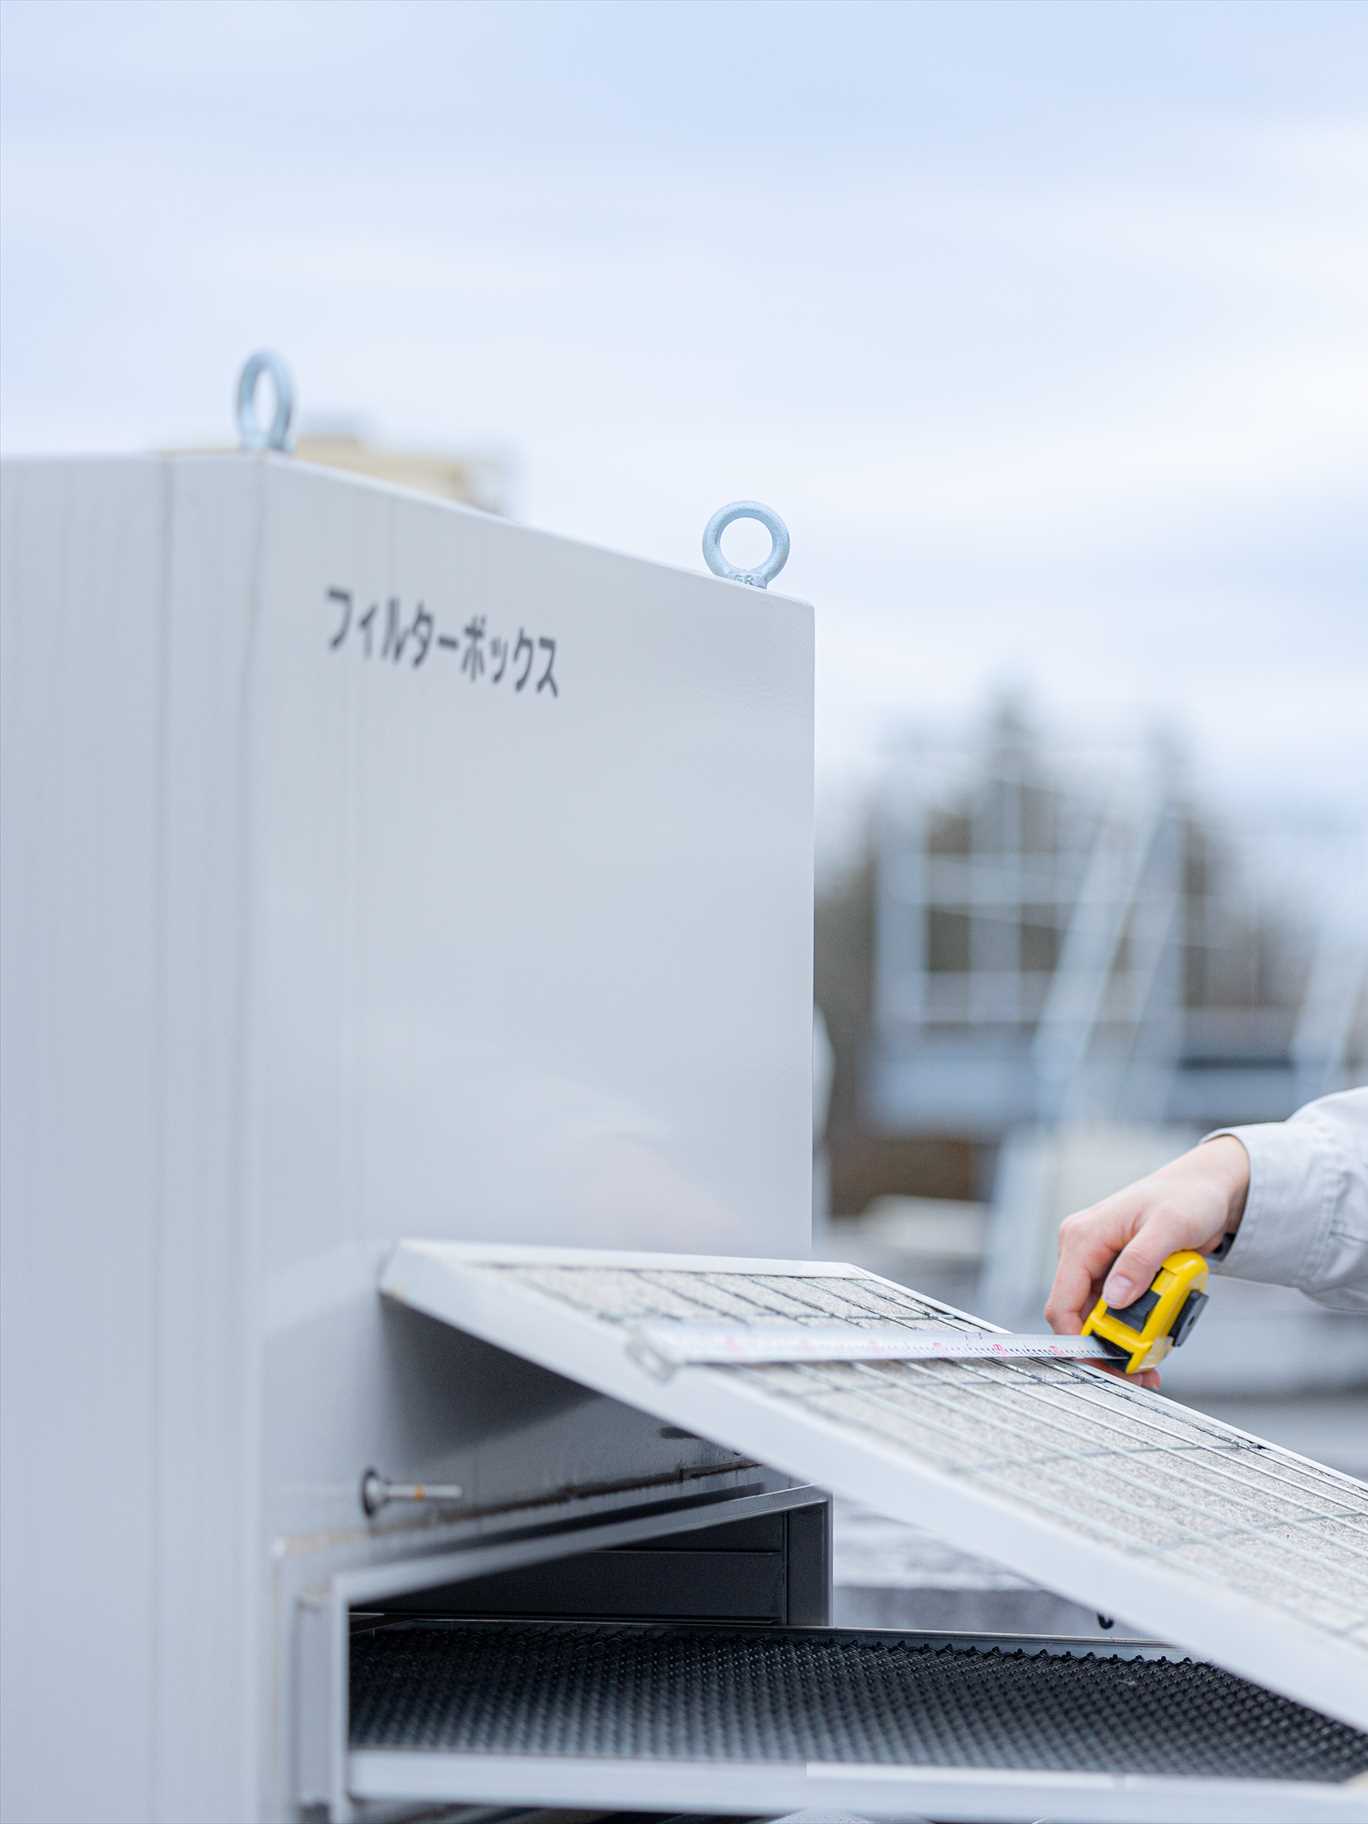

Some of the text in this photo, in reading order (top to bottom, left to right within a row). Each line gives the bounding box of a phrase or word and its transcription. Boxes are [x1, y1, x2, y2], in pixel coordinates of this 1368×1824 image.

[327, 586, 559, 699] フィルターボックス
